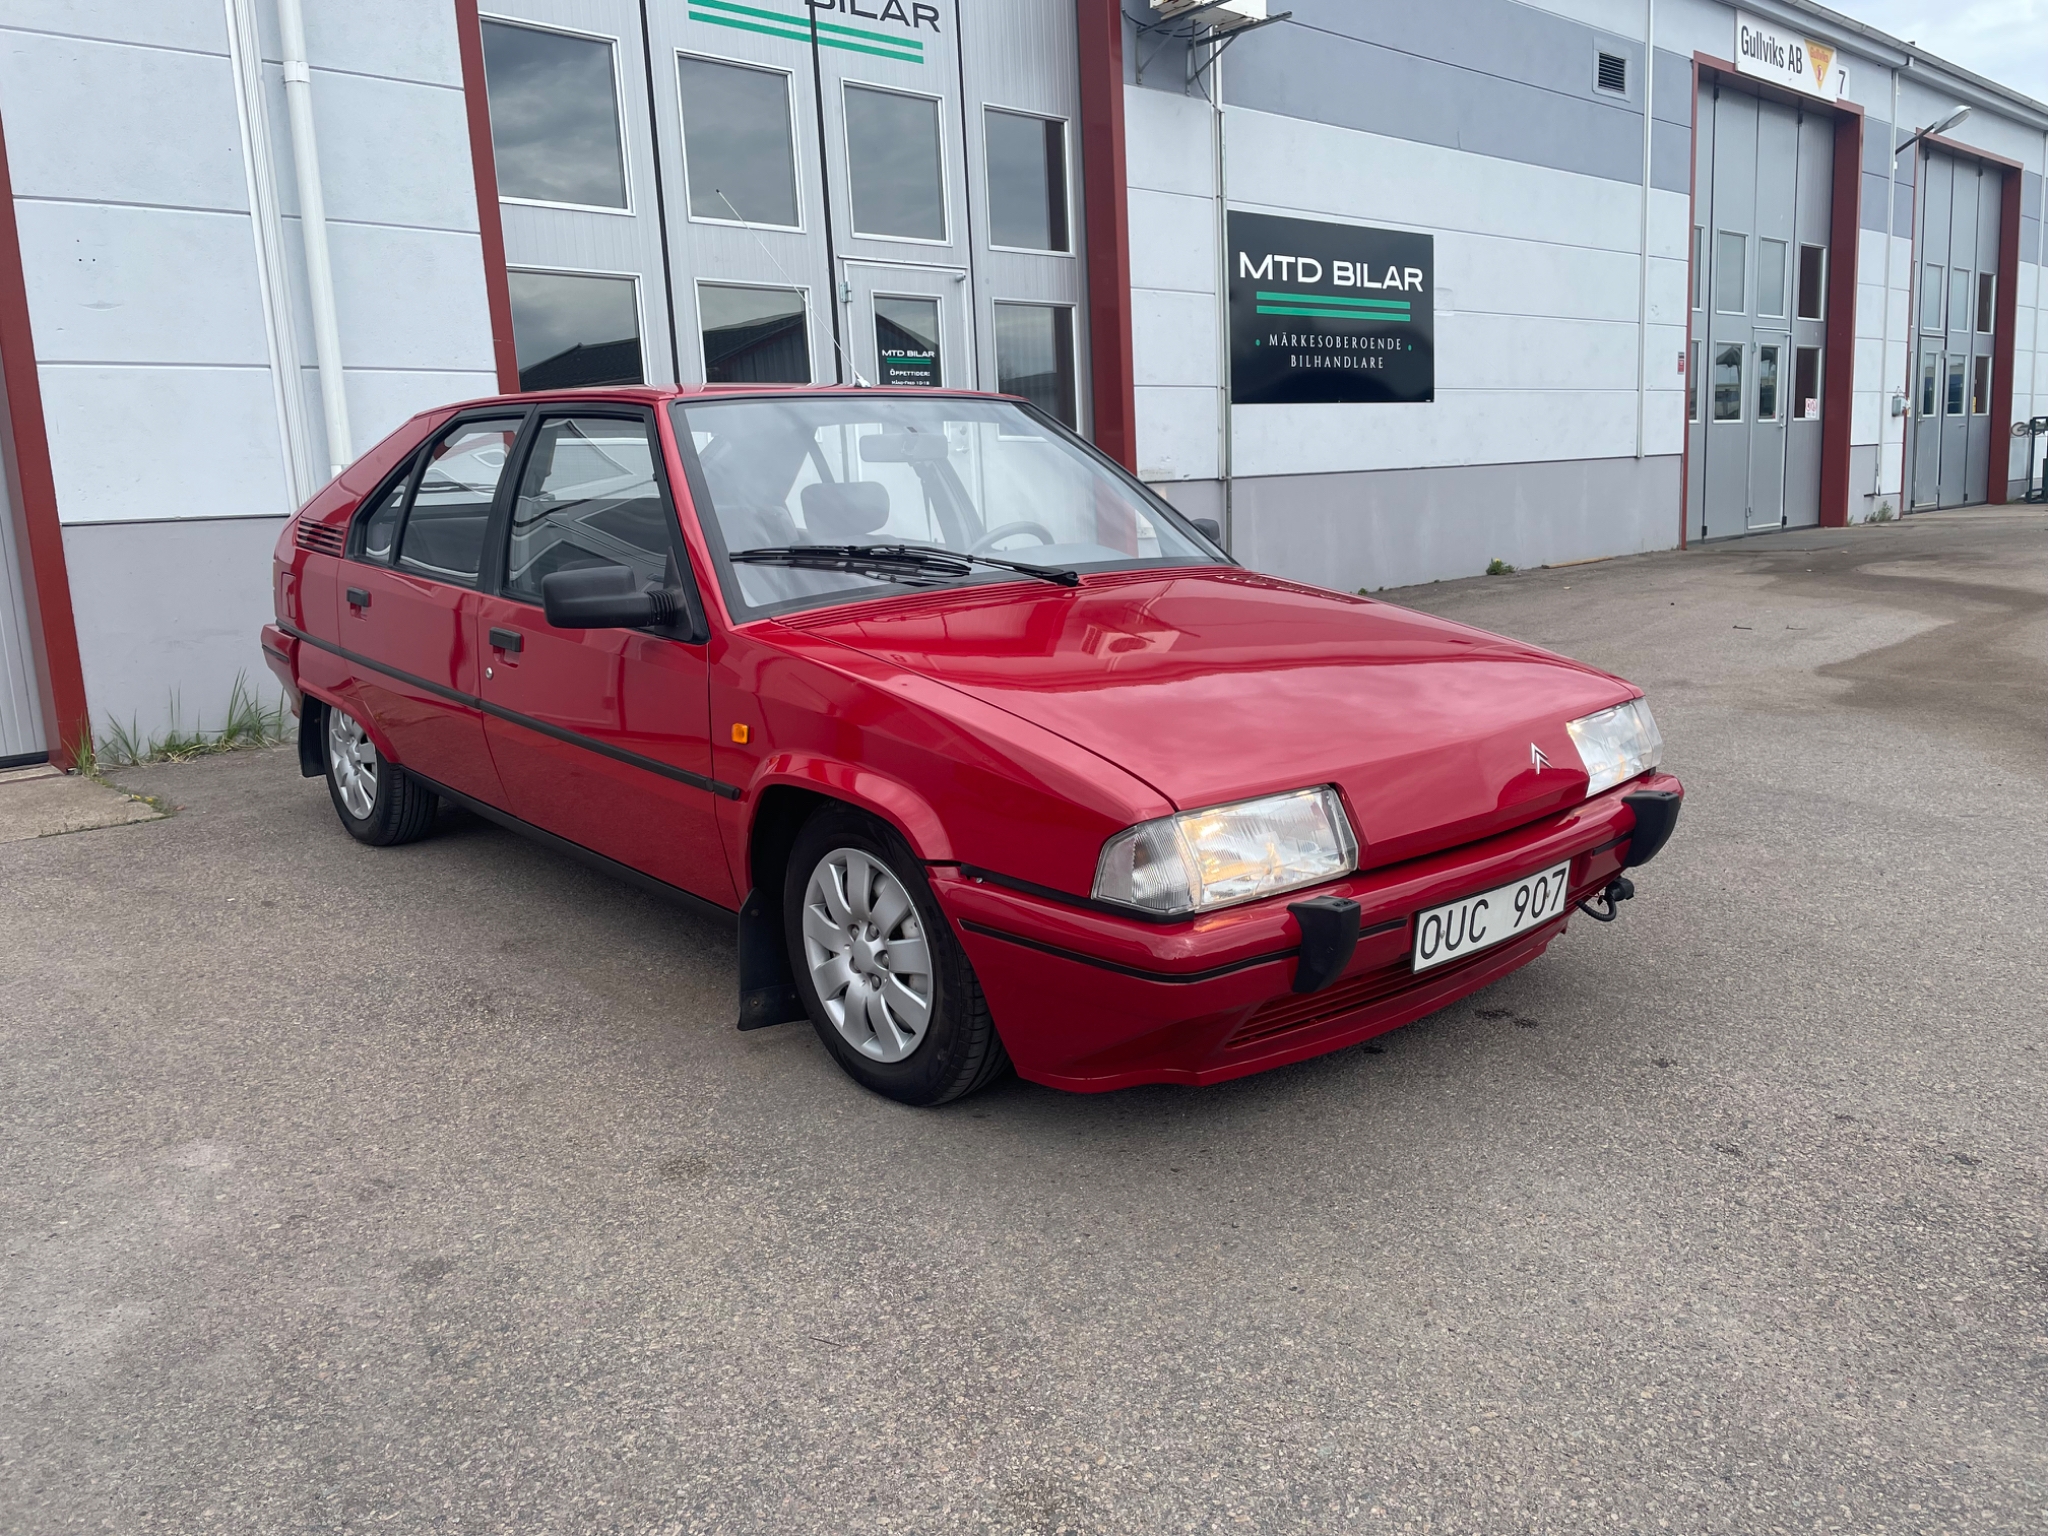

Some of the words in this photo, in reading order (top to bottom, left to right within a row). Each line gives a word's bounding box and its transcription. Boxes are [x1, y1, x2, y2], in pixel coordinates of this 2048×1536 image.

[1741, 25, 1785, 69] Gullviks
[1788, 44, 1803, 75] AB
[1838, 69, 1846, 95] 7
[1239, 251, 1323, 283] MTD
[1333, 260, 1424, 292] BILAR
[882, 349, 905, 357] MTD
[906, 350, 935, 358] BILAR
[1269, 332, 1402, 350] MÄRKESOBEROENDE
[1290, 355, 1384, 369] BILHANDLARE
[1420, 898, 1489, 960] OUC
[1513, 867, 1567, 928] 907
